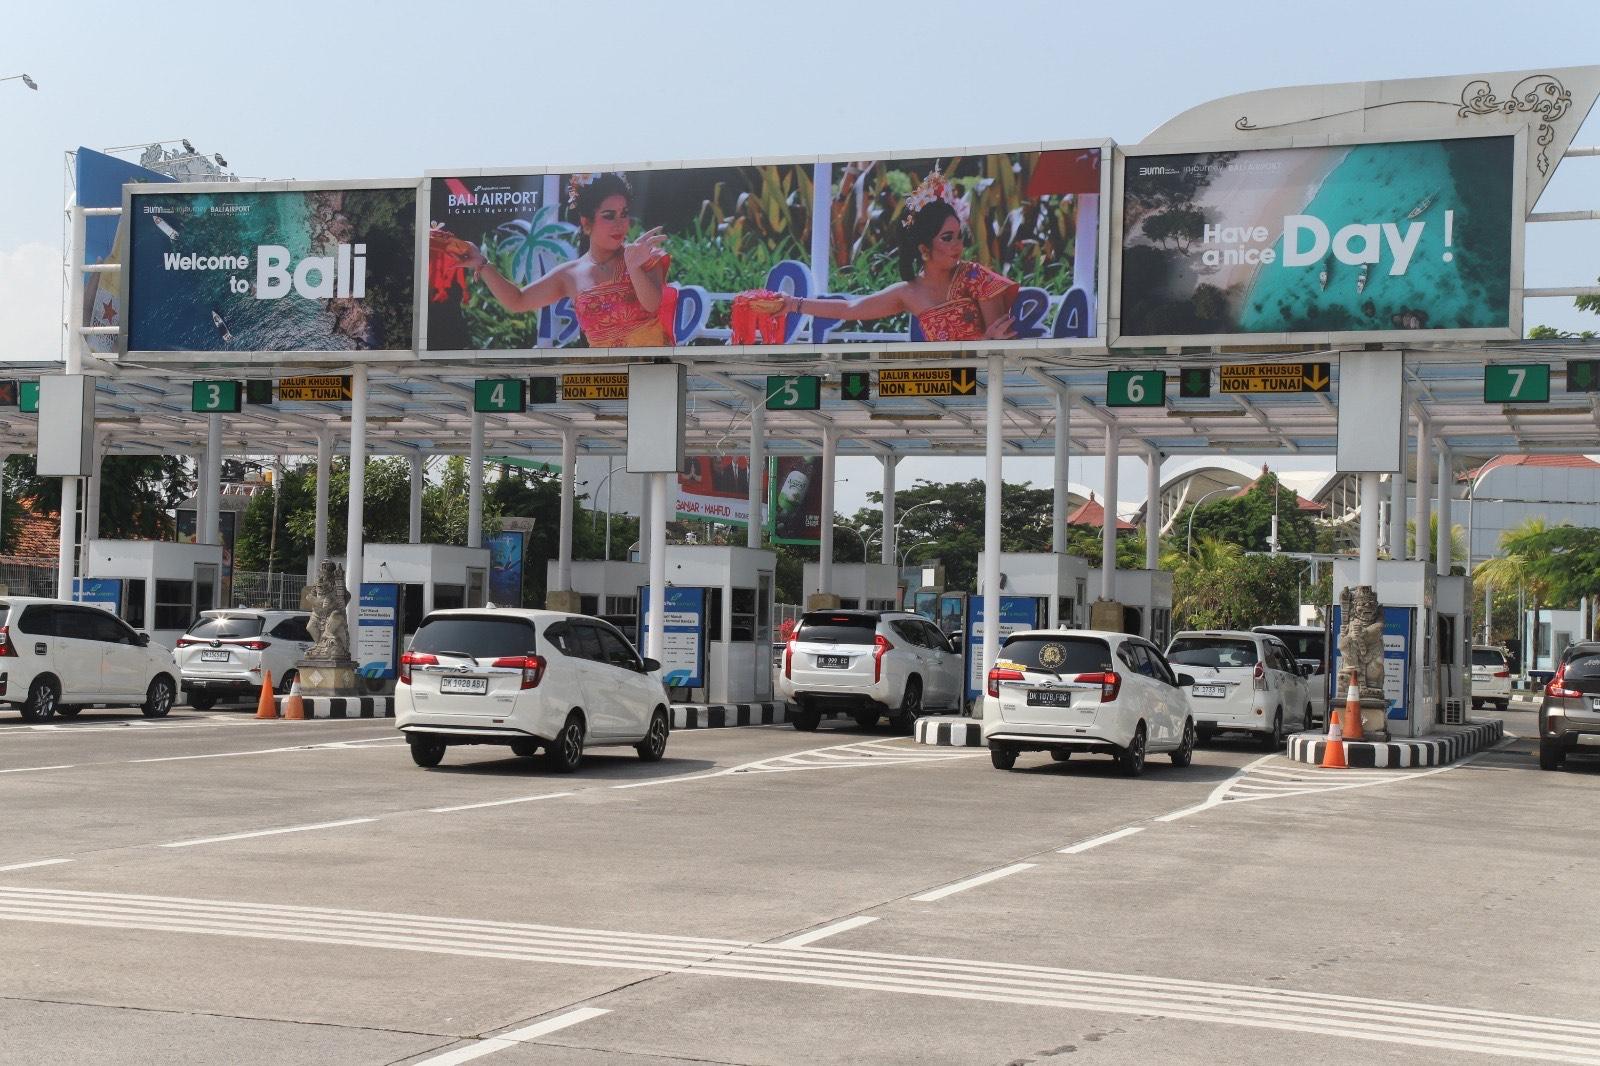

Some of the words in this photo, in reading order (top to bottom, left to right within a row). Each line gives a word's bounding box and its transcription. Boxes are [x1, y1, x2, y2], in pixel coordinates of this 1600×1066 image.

[448, 194, 477, 206] BALI
[481, 192, 538, 205] AIRPORT
[1202, 224, 1269, 244] Have
[1283, 214, 1425, 276] Day
[164, 252, 249, 270] Welcome
[1202, 248, 1220, 266] a
[1224, 244, 1276, 265] nice
[256, 244, 367, 299] Bali
[230, 276, 248, 294] to
[564, 376, 591, 385] JALUR
[594, 374, 628, 384] KHUSUS
[882, 371, 909, 380] JALUR
[913, 371, 951, 380] KHUSUS
[1223, 367, 1256, 376] JALUR
[1258, 366, 1301, 376] KHUSUS
[282, 378, 307, 387] JALUR
[309, 376, 340, 387] KHUSUS
[880, 382, 905, 394] NON
[916, 382, 950, 394] TUNAI
[1127, 375, 1144, 402] 6
[1222, 378, 1249, 391] NON
[1261, 378, 1301, 391] TUNAI
[1508, 369, 1526, 398] 7
[206, 384, 221, 408] 3
[281, 389, 301, 400] NON
[311, 388, 341, 400] TUNAI
[490, 383, 505, 407] 4
[564, 388, 587, 398] NON
[596, 386, 628, 398] TUNAI
[784, 380, 799, 406] 5
[442, 679, 452, 687] DK
